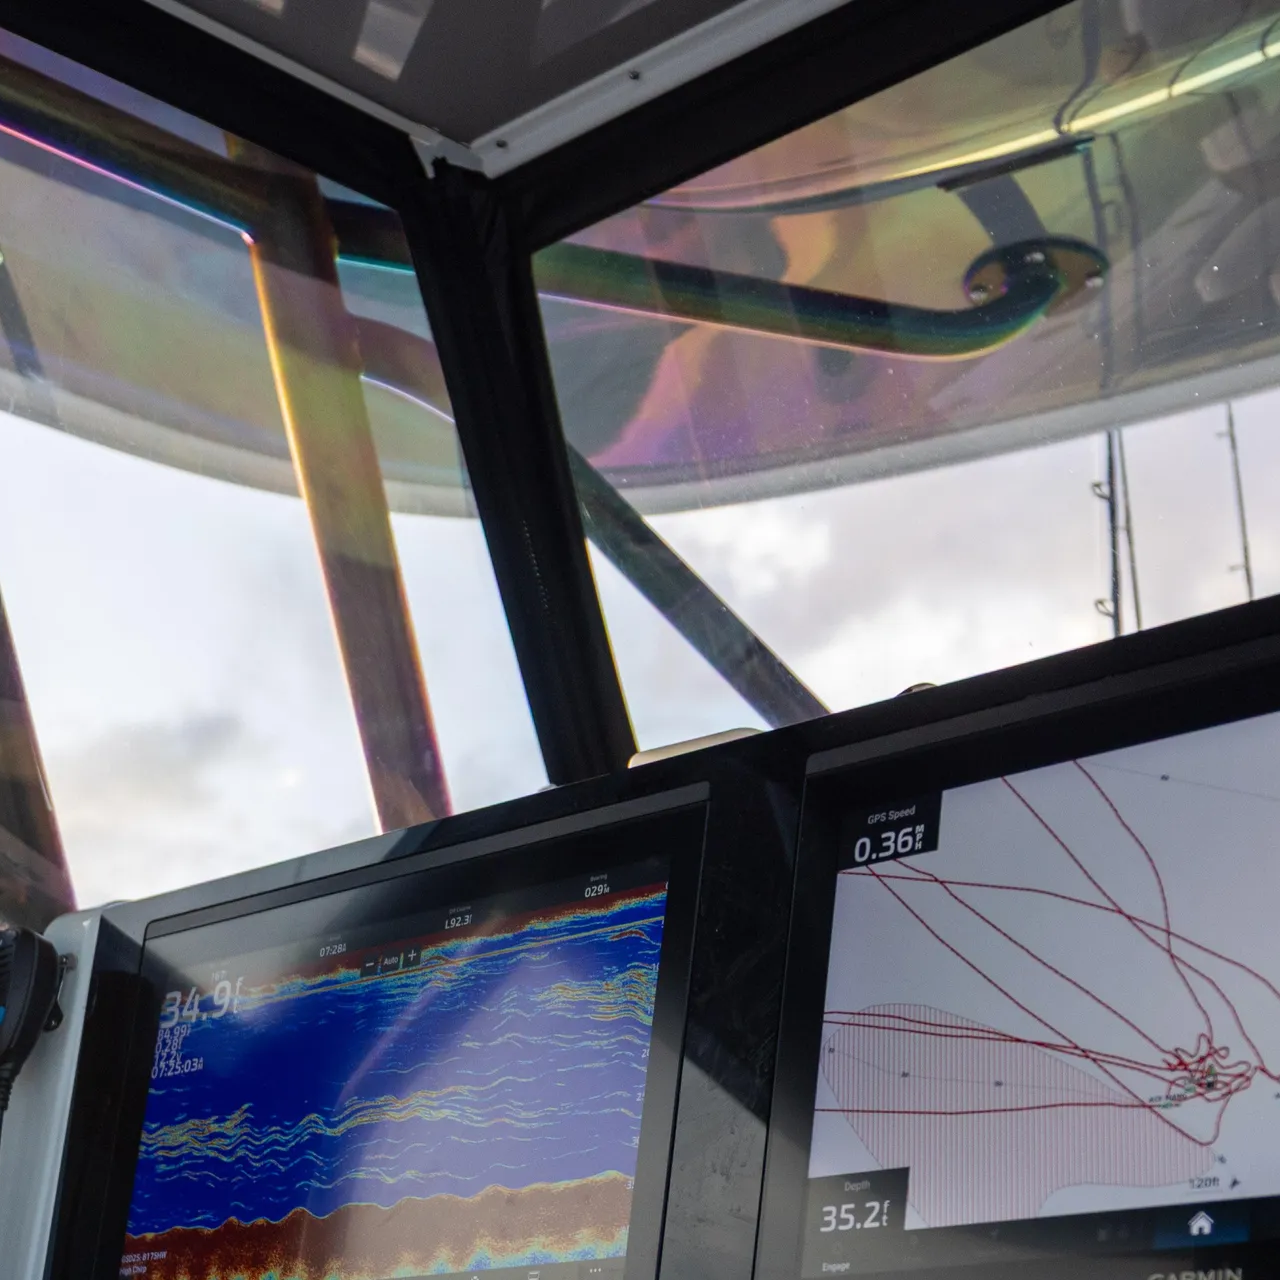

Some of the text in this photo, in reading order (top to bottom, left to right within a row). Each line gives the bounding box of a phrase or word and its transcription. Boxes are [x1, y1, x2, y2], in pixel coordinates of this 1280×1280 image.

[867, 804, 917, 825] GPS Speed
[854, 826, 914, 863] 0.36
[383, 956, 399, 966] Auto
[160, 980, 232, 1029] 34.9
[844, 1180, 871, 1192] Depth
[820, 1201, 881, 1232] 35.2
[821, 1262, 851, 1273] Engage
